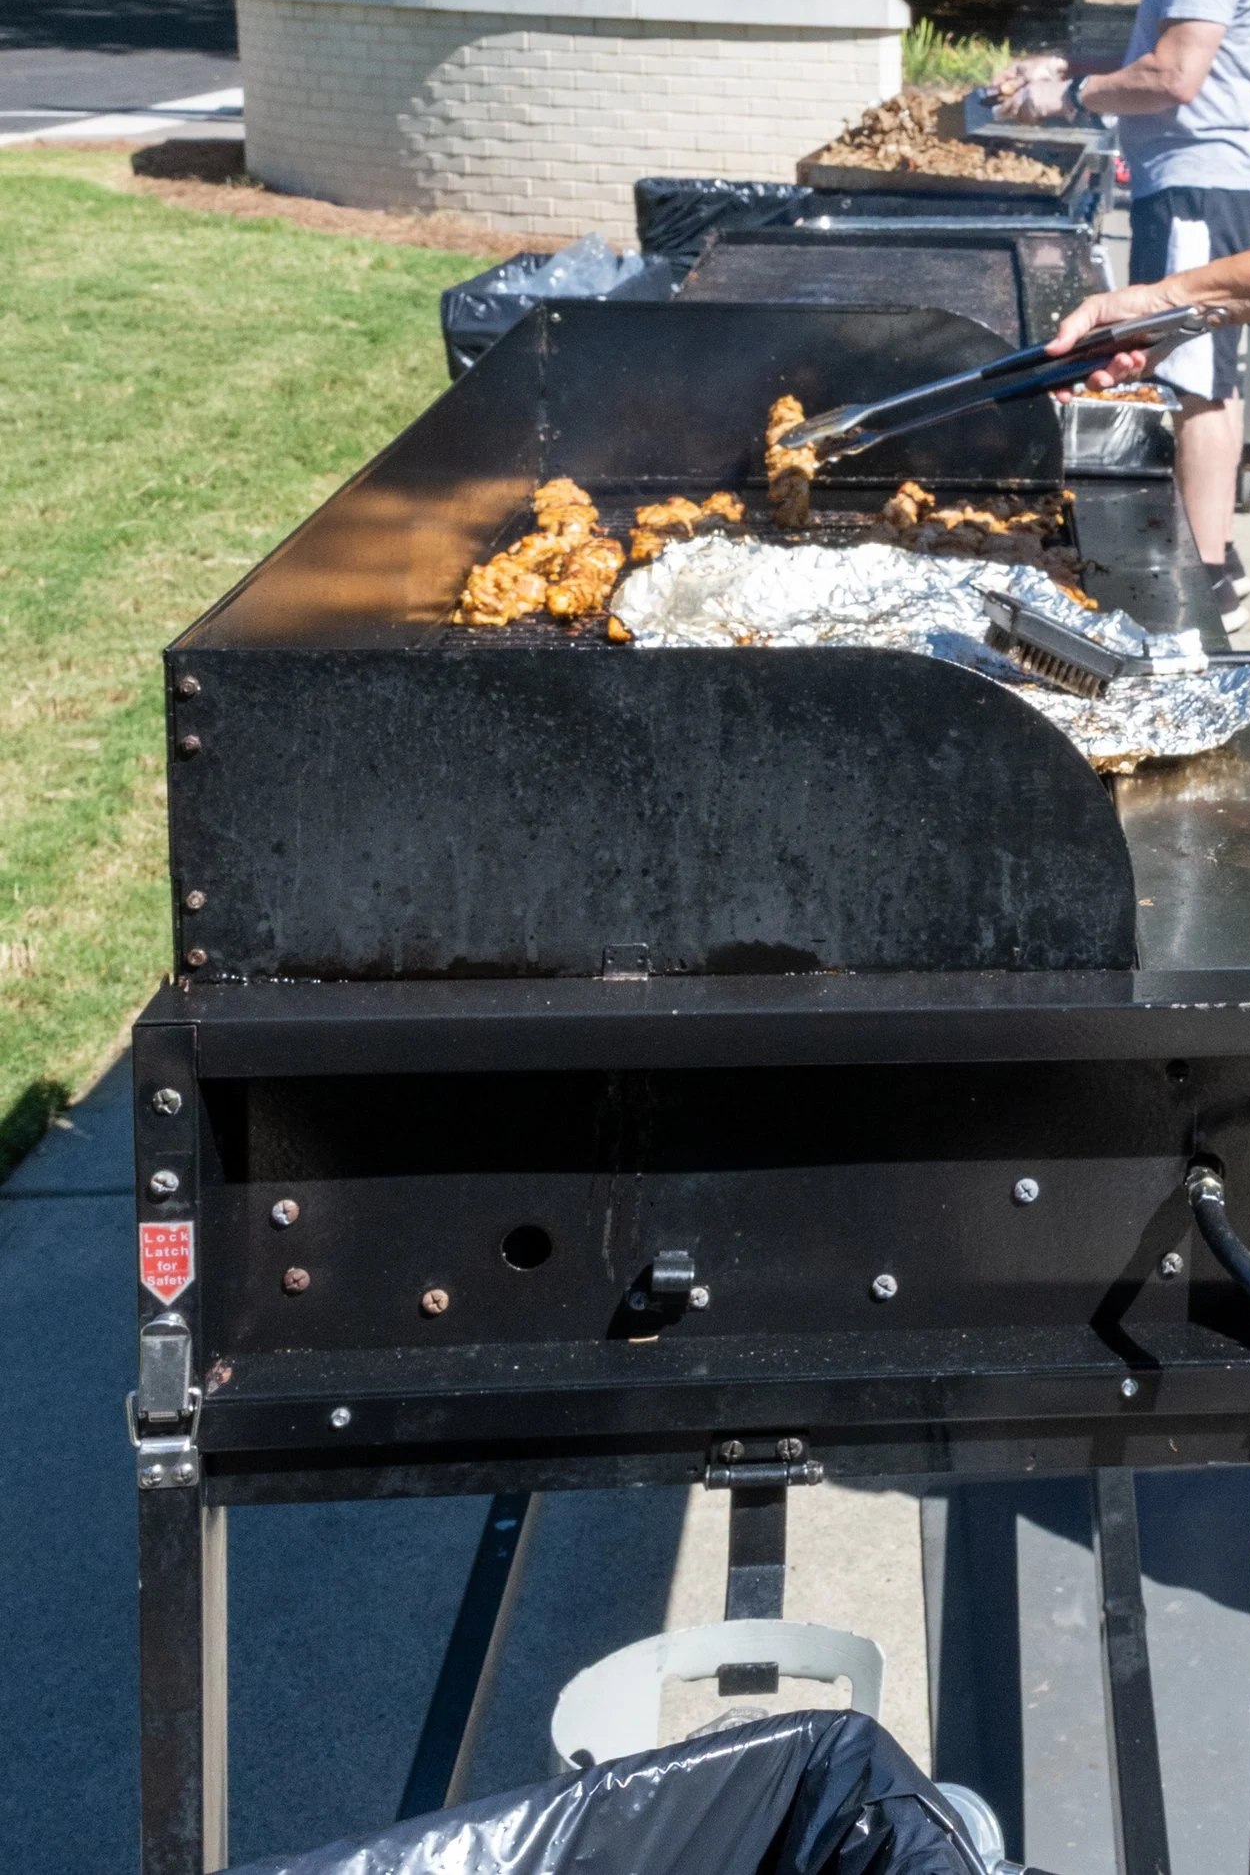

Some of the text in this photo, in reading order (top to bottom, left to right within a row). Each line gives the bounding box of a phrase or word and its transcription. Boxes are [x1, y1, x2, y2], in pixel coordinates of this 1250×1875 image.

[144, 1232, 189, 1243] Lock
[145, 1246, 190, 1257] Latch
[156, 1260, 178, 1271] for
[146, 1274, 190, 1286] Safety
